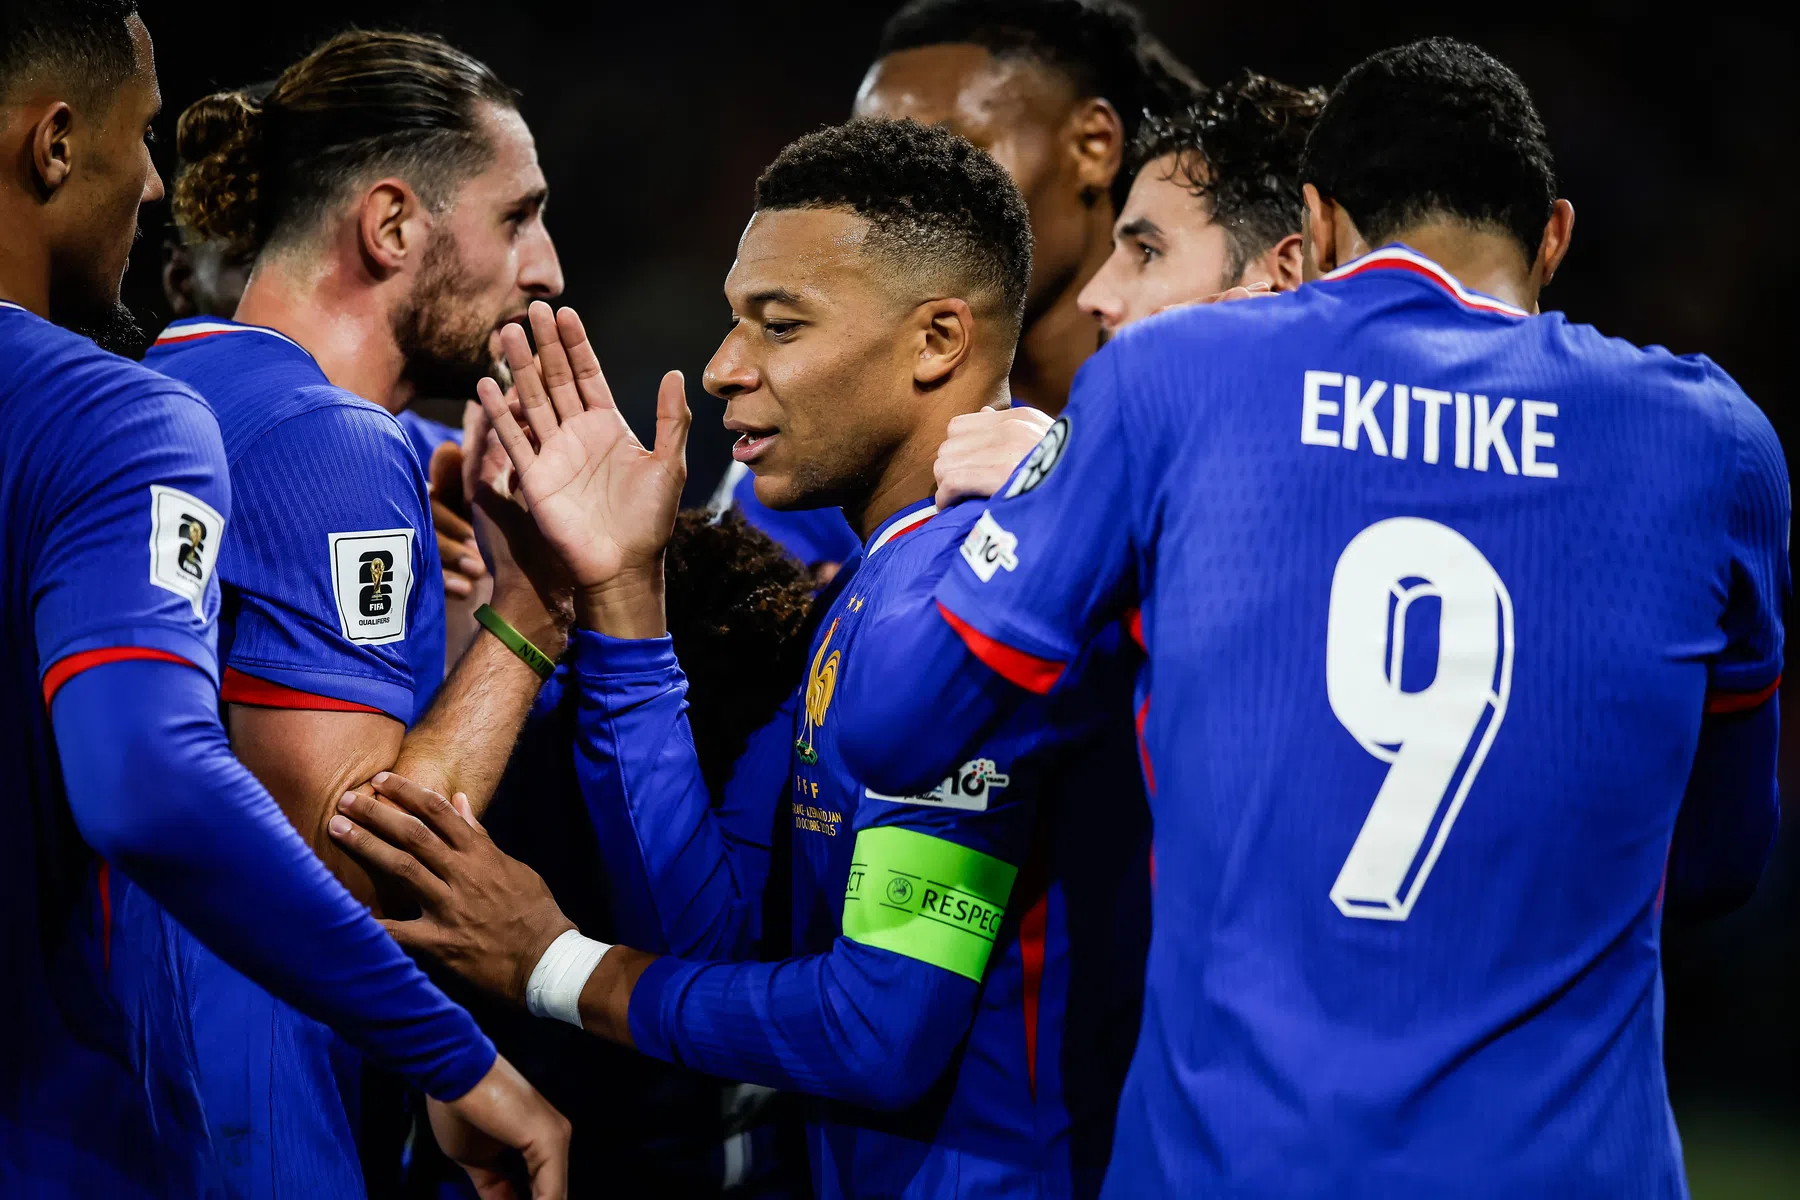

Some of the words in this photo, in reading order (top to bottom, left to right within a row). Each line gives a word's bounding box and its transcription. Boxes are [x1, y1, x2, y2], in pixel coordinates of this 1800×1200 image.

[1301, 370, 1559, 479] EKITIKE
[358, 616, 391, 626] QUALIFIERS
[369, 602, 384, 612] FIFA
[1326, 516, 1515, 922] 9
